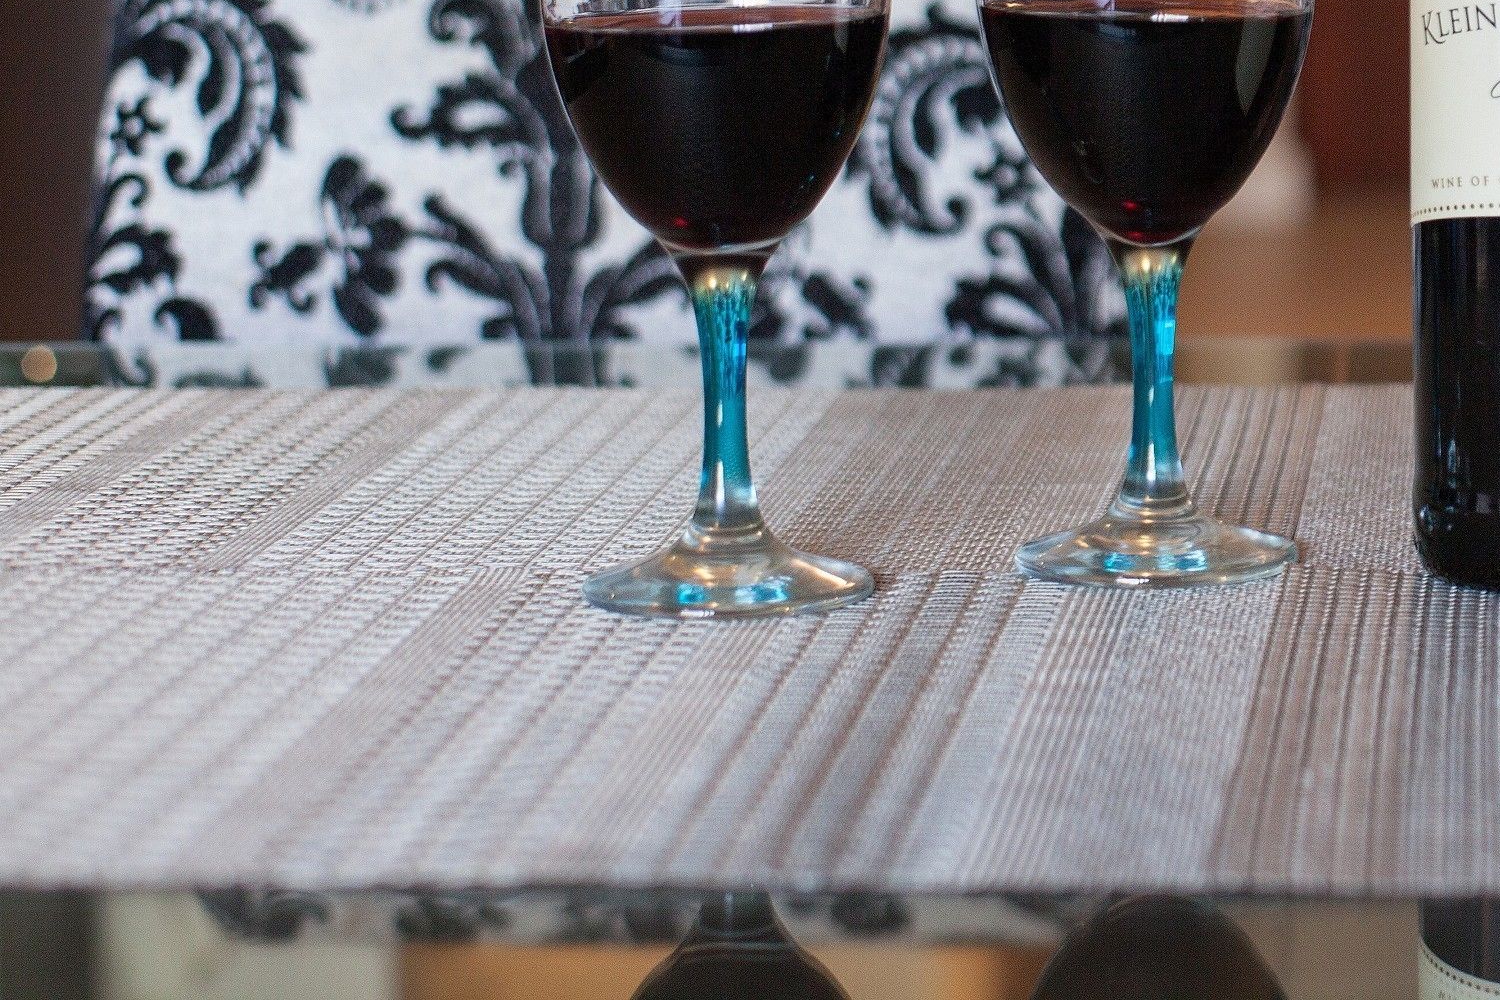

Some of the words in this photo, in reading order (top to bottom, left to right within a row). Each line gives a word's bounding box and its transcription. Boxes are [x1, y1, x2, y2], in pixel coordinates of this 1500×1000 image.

[1421, 3, 1497, 46] KLEIN
[1431, 176, 1463, 189] WINE
[1471, 175, 1489, 187] OF
